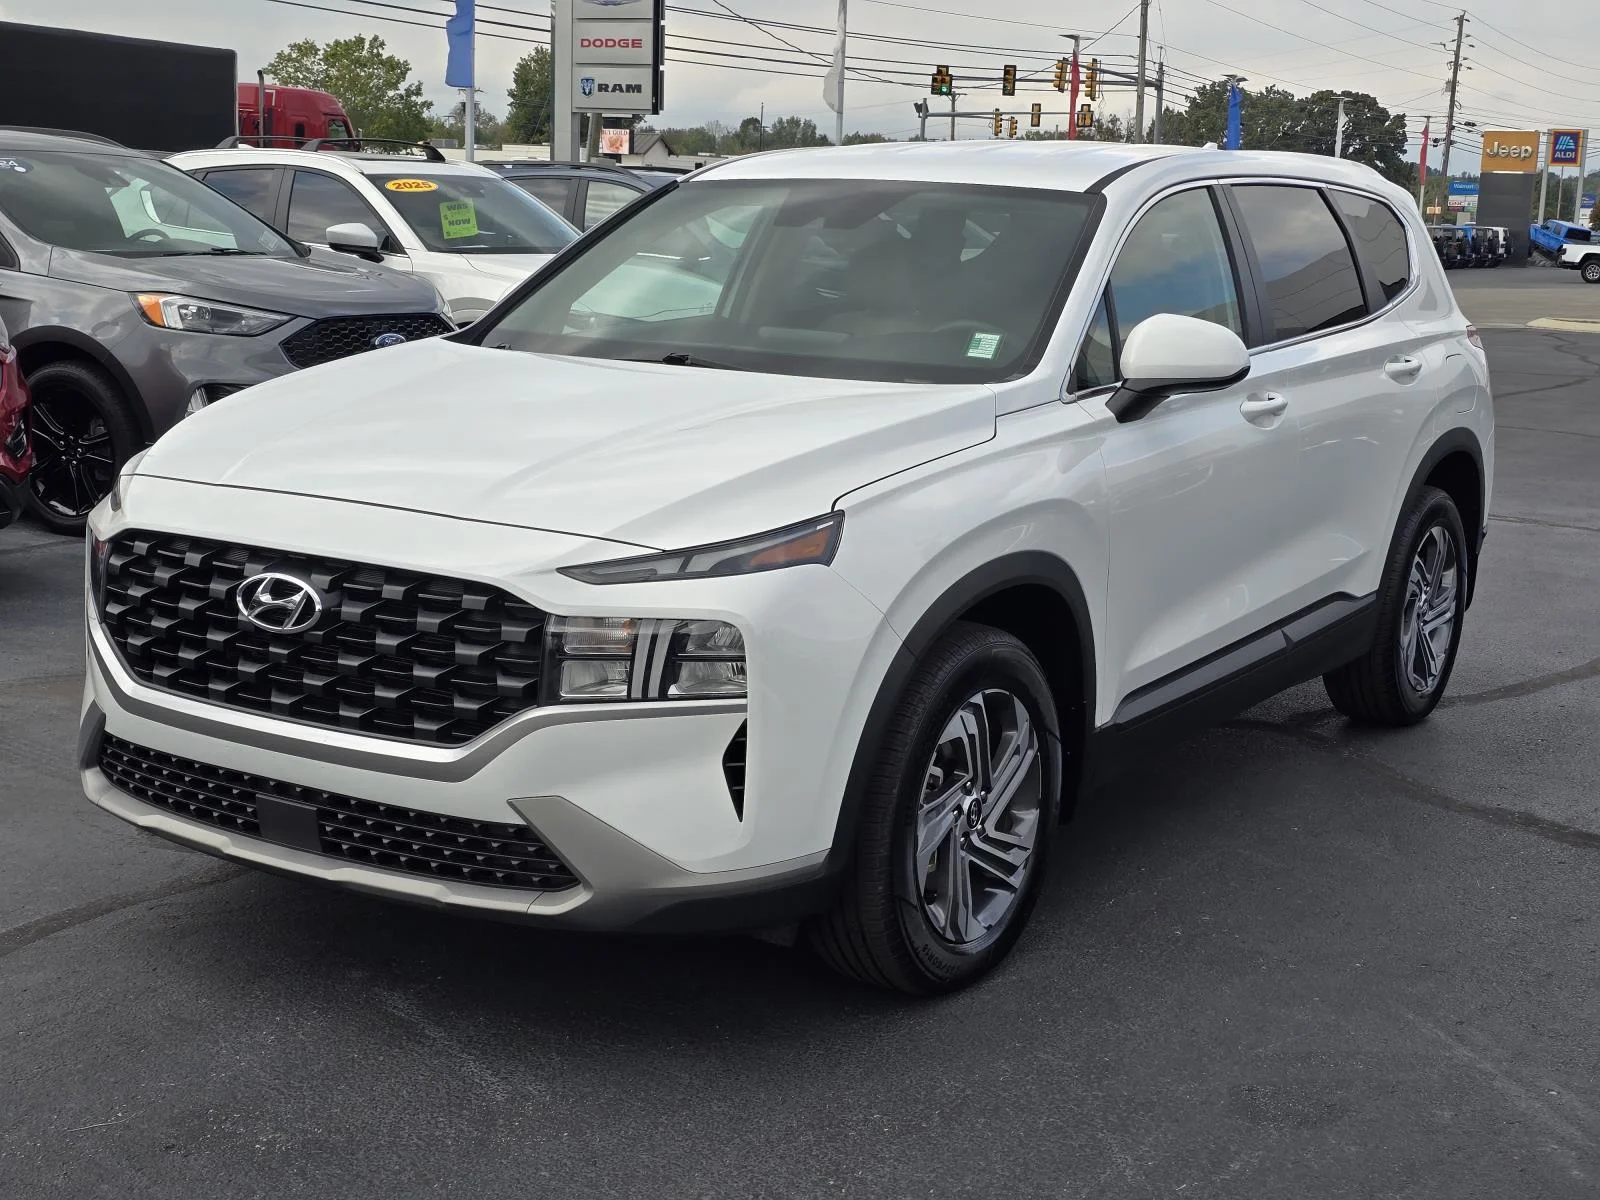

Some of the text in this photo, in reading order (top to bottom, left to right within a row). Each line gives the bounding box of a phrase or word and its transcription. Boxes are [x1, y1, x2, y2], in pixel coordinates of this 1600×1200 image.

[580, 38, 643, 48] DODGE
[597, 83, 642, 94] RAM
[1486, 141, 1533, 161] Jeep
[1554, 151, 1575, 159] ALDI
[392, 181, 433, 190] 2025
[448, 217, 471, 226] NOW
